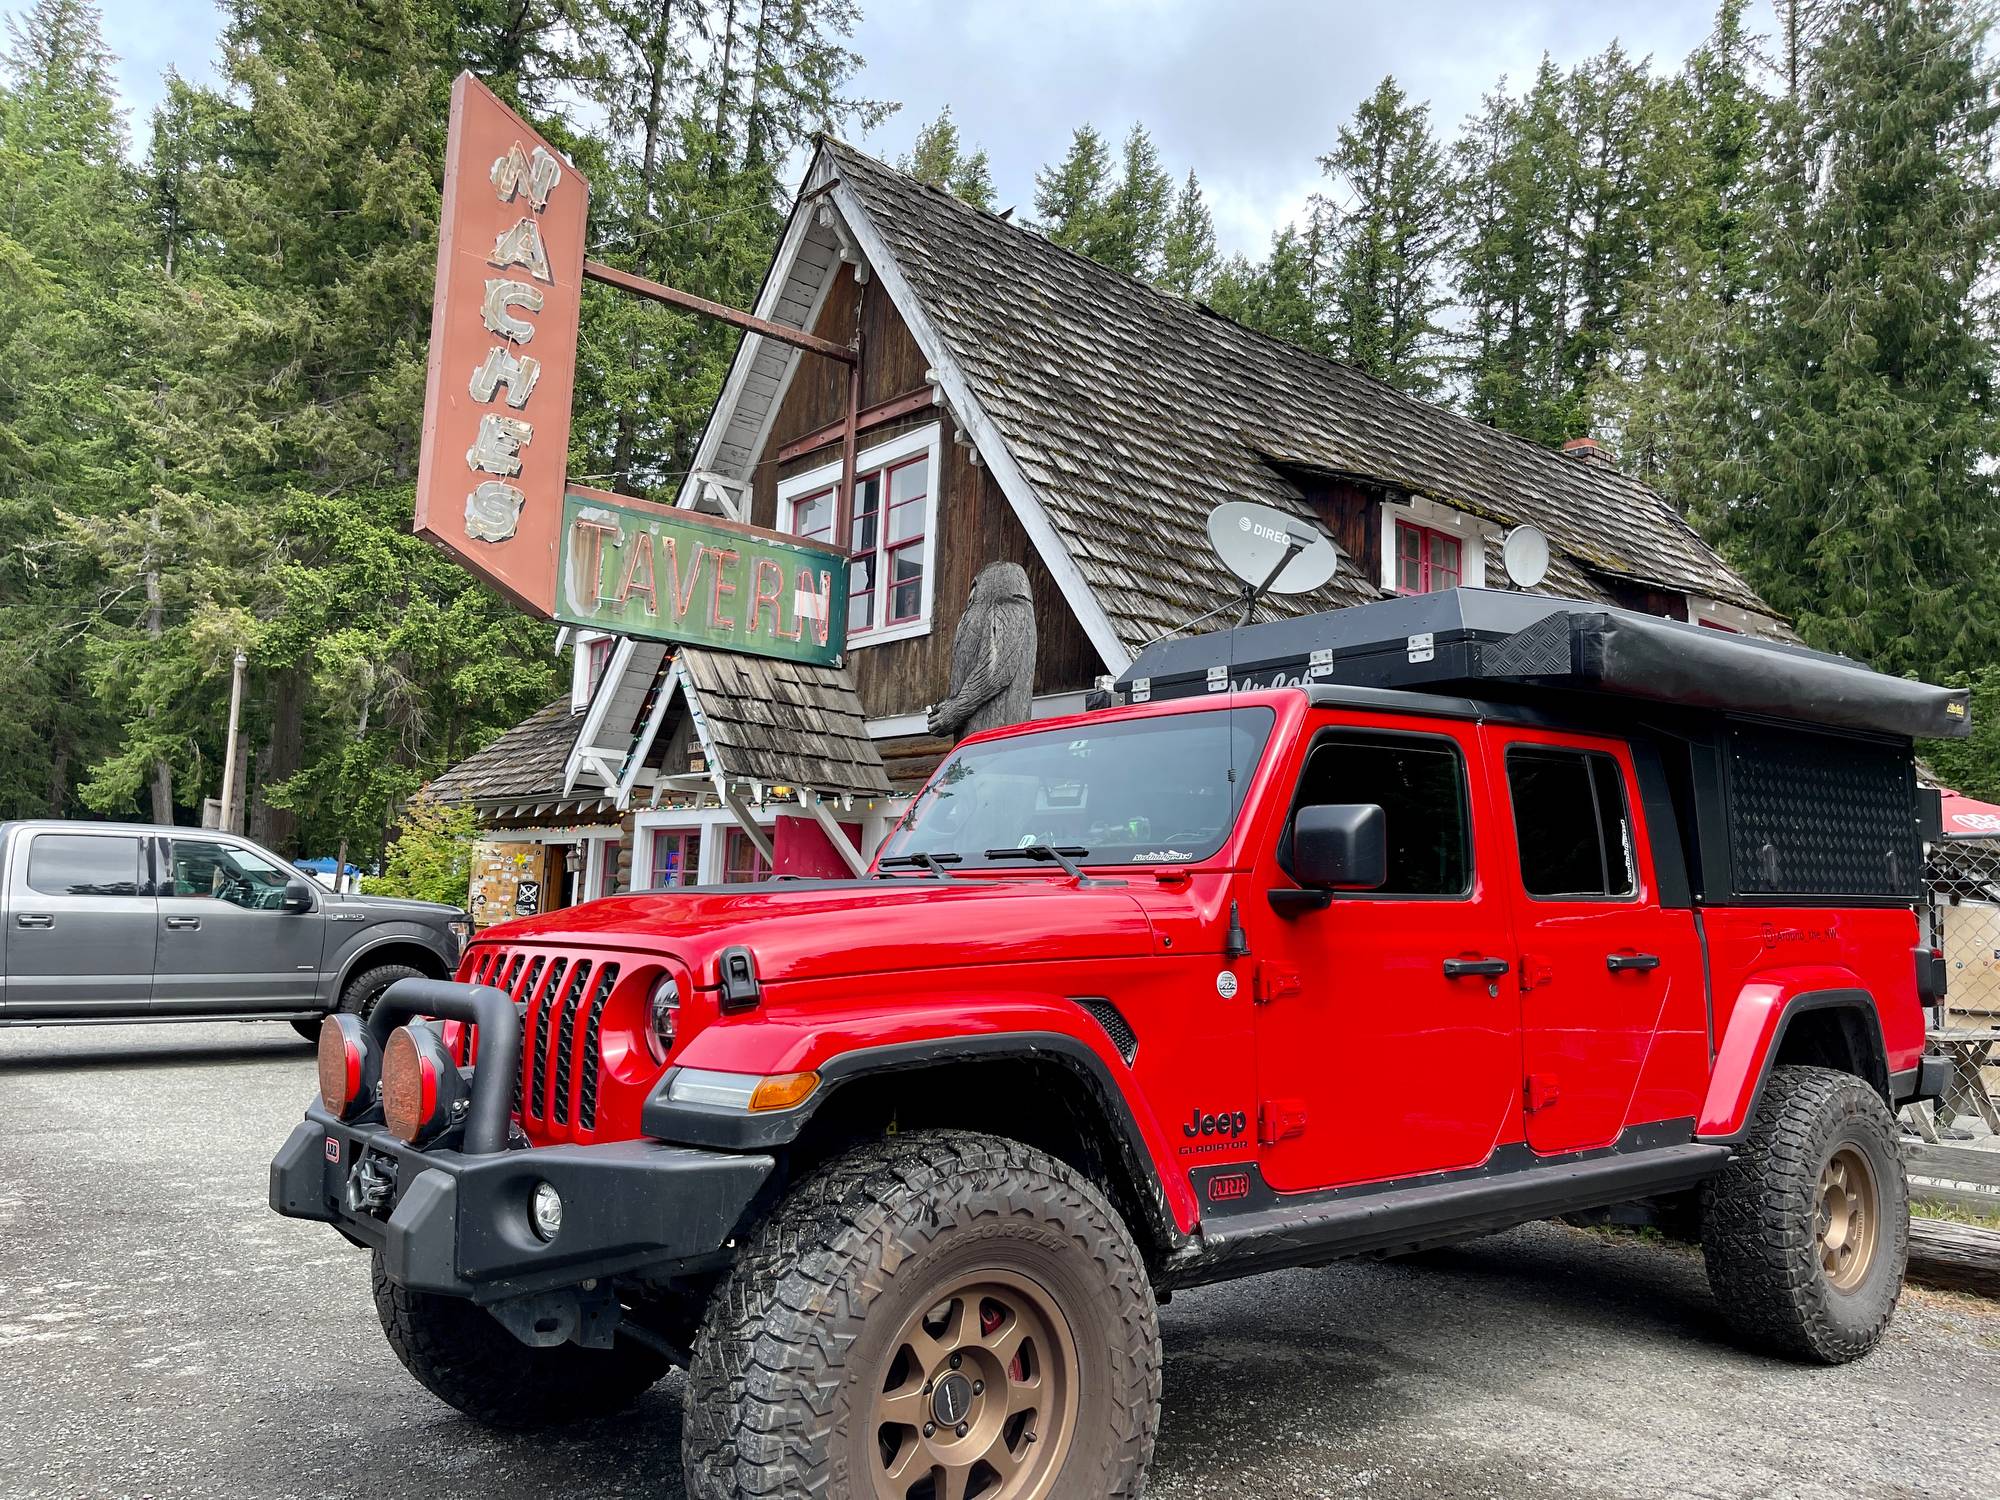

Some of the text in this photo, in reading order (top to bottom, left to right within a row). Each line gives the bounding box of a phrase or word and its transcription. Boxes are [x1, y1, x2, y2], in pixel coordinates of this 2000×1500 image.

[465, 140, 562, 542] NACHES
[1253, 523, 1292, 545] DIREC
[568, 507, 832, 646] TAVERN
[1183, 1107, 1247, 1138] Jeep
[1178, 1140, 1249, 1155] GLADIATOR
